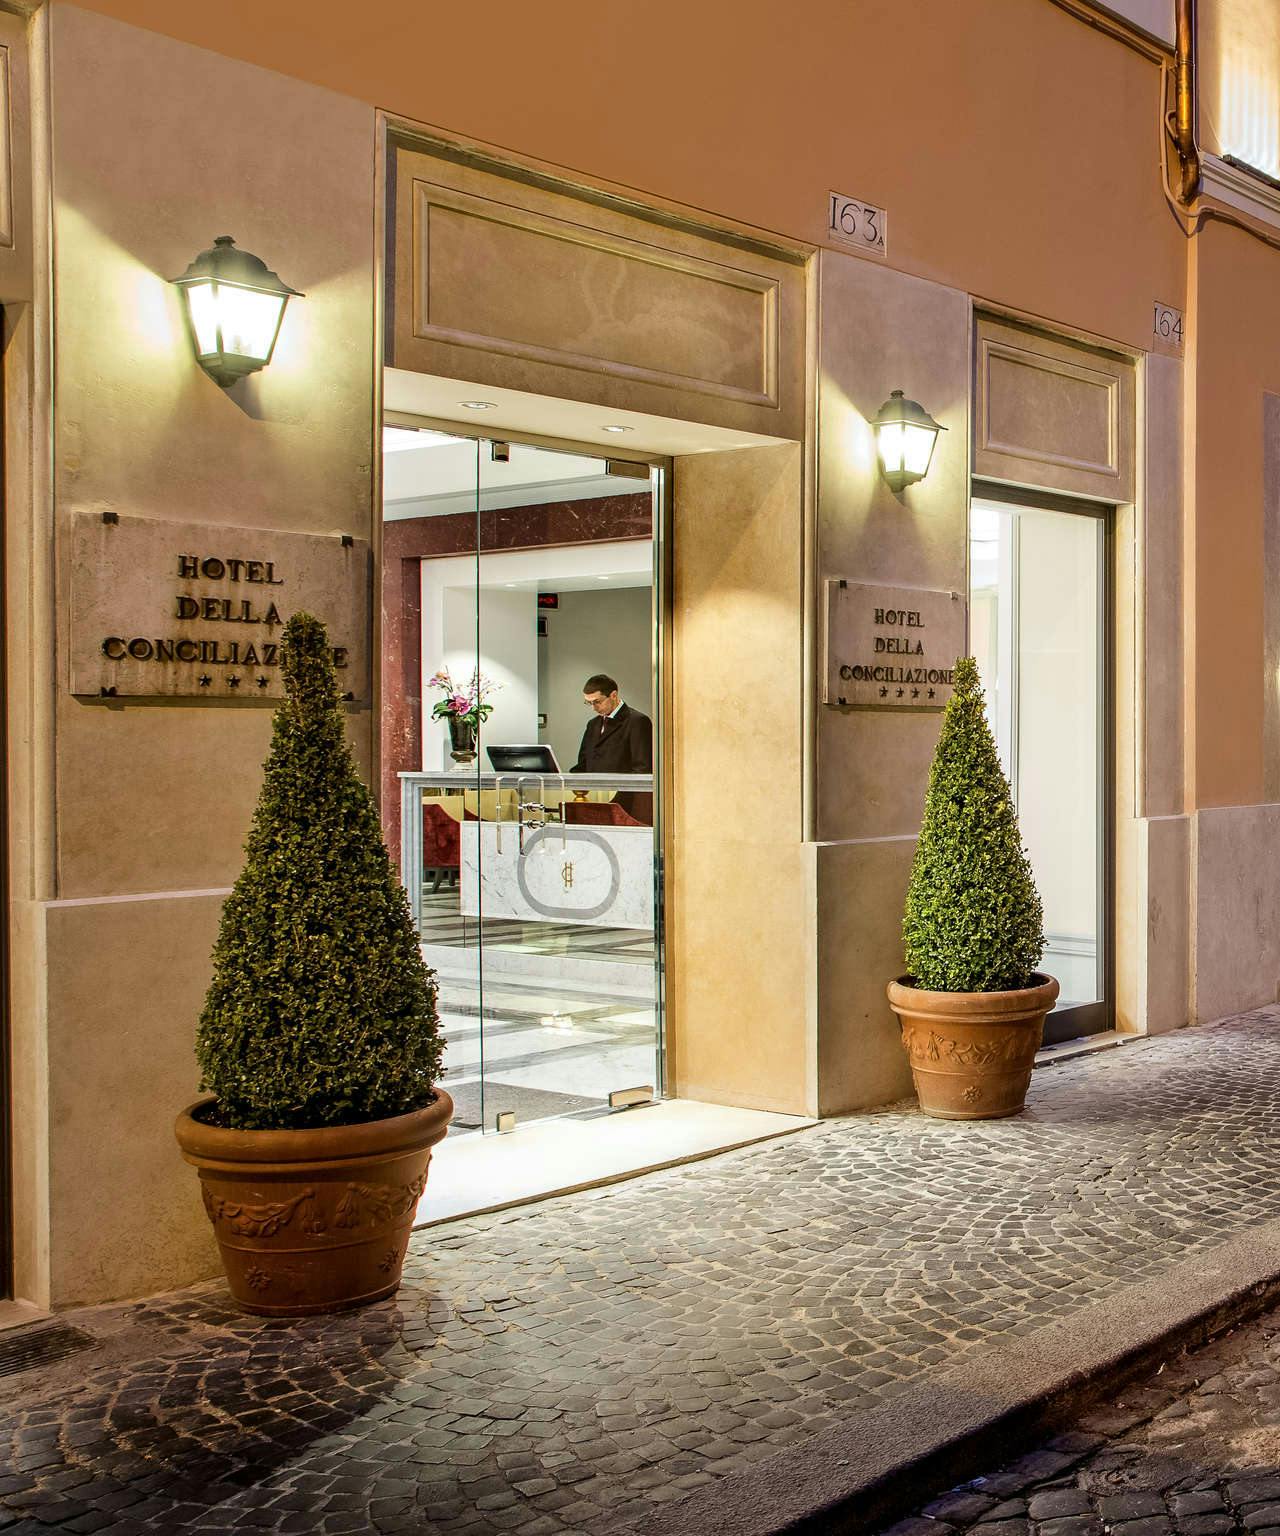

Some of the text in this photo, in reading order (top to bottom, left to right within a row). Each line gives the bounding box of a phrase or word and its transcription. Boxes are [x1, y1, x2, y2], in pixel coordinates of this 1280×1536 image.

[1153, 307, 1184, 342] 164
[177, 554, 284, 585] HOTEL
[175, 595, 284, 625] DELLA
[873, 608, 925, 628] HOTEL
[102, 637, 349, 669] CONCILIAZE
[873, 637, 925, 656] DELLA
[839, 665, 955, 685] CONCILIAZIONE
